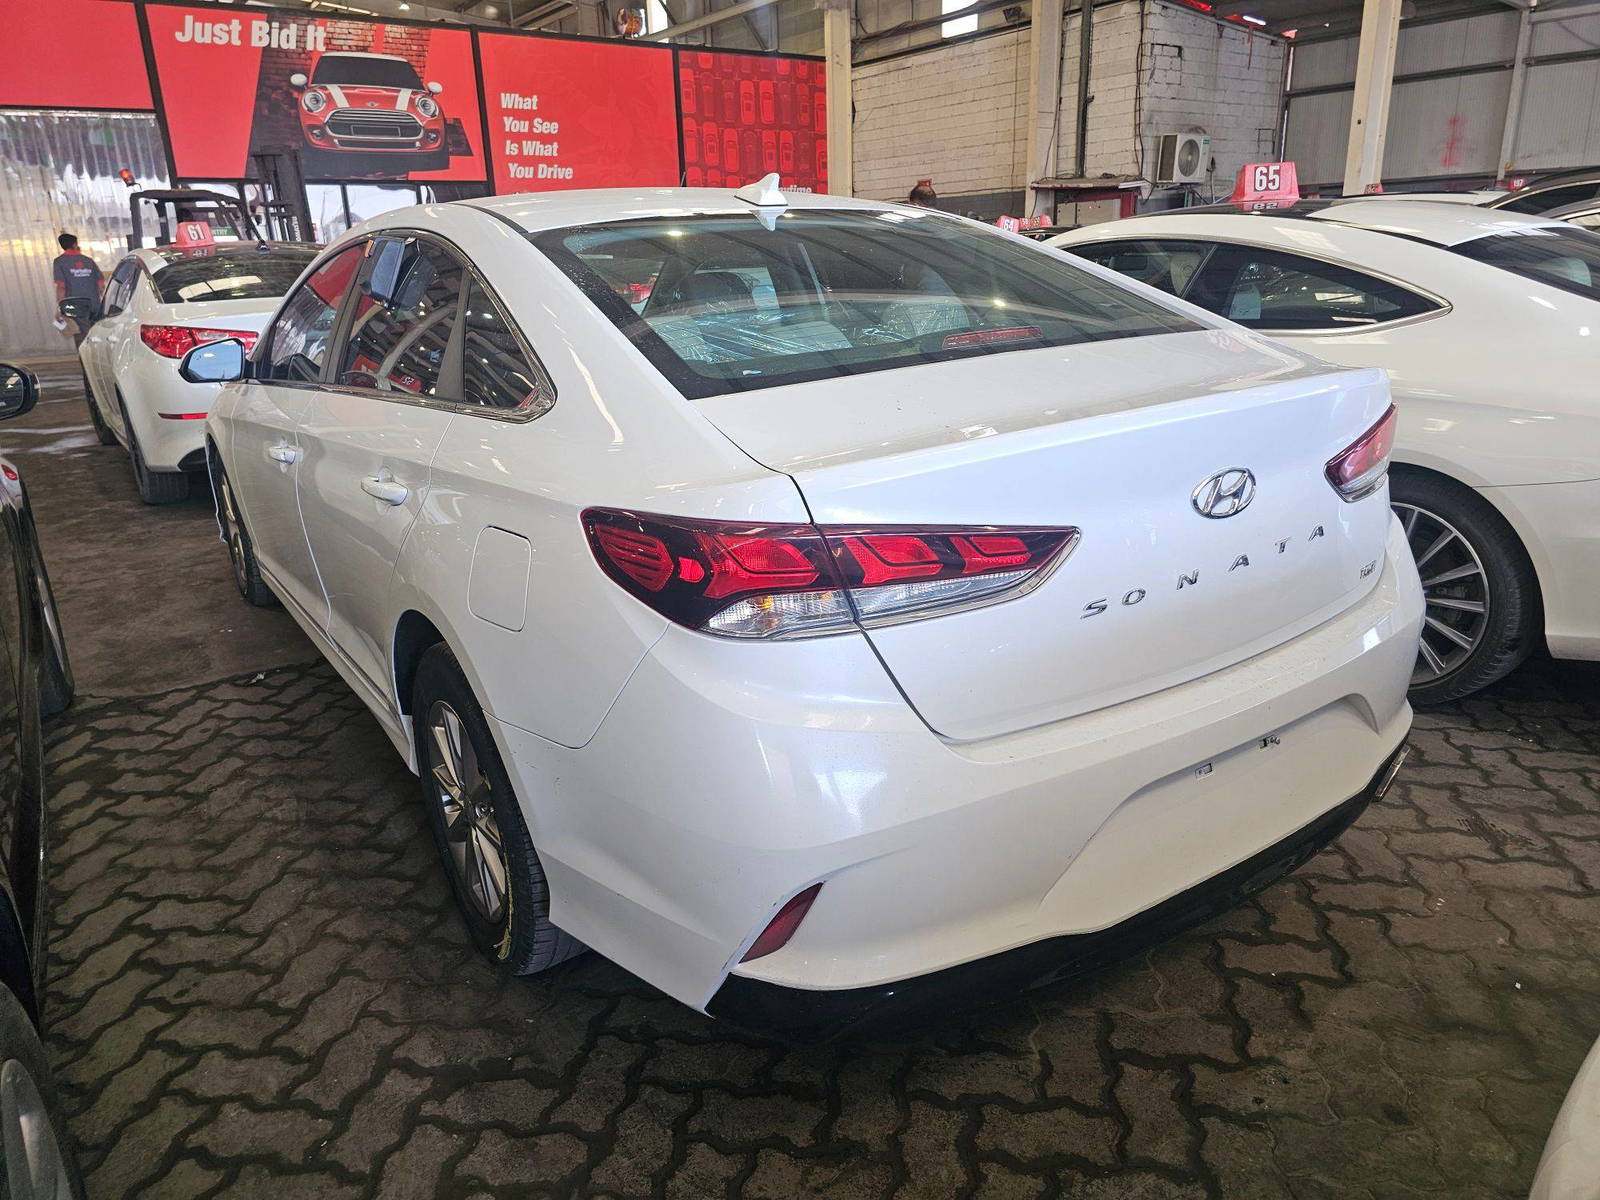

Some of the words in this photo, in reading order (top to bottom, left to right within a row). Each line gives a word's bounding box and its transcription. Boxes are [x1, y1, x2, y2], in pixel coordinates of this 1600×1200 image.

[175, 15, 242, 46] Just
[251, 20, 298, 49] Bid
[306, 24, 326, 52] It
[500, 93, 538, 110] What
[503, 116, 529, 132] You
[533, 117, 559, 134] See
[505, 140, 519, 155] Is
[522, 140, 559, 156] What
[508, 163, 534, 178] You
[537, 163, 573, 179] Drive
[1254, 165, 1280, 191] 65
[187, 224, 205, 241] 61
[1080, 524, 1324, 619] SONATA
